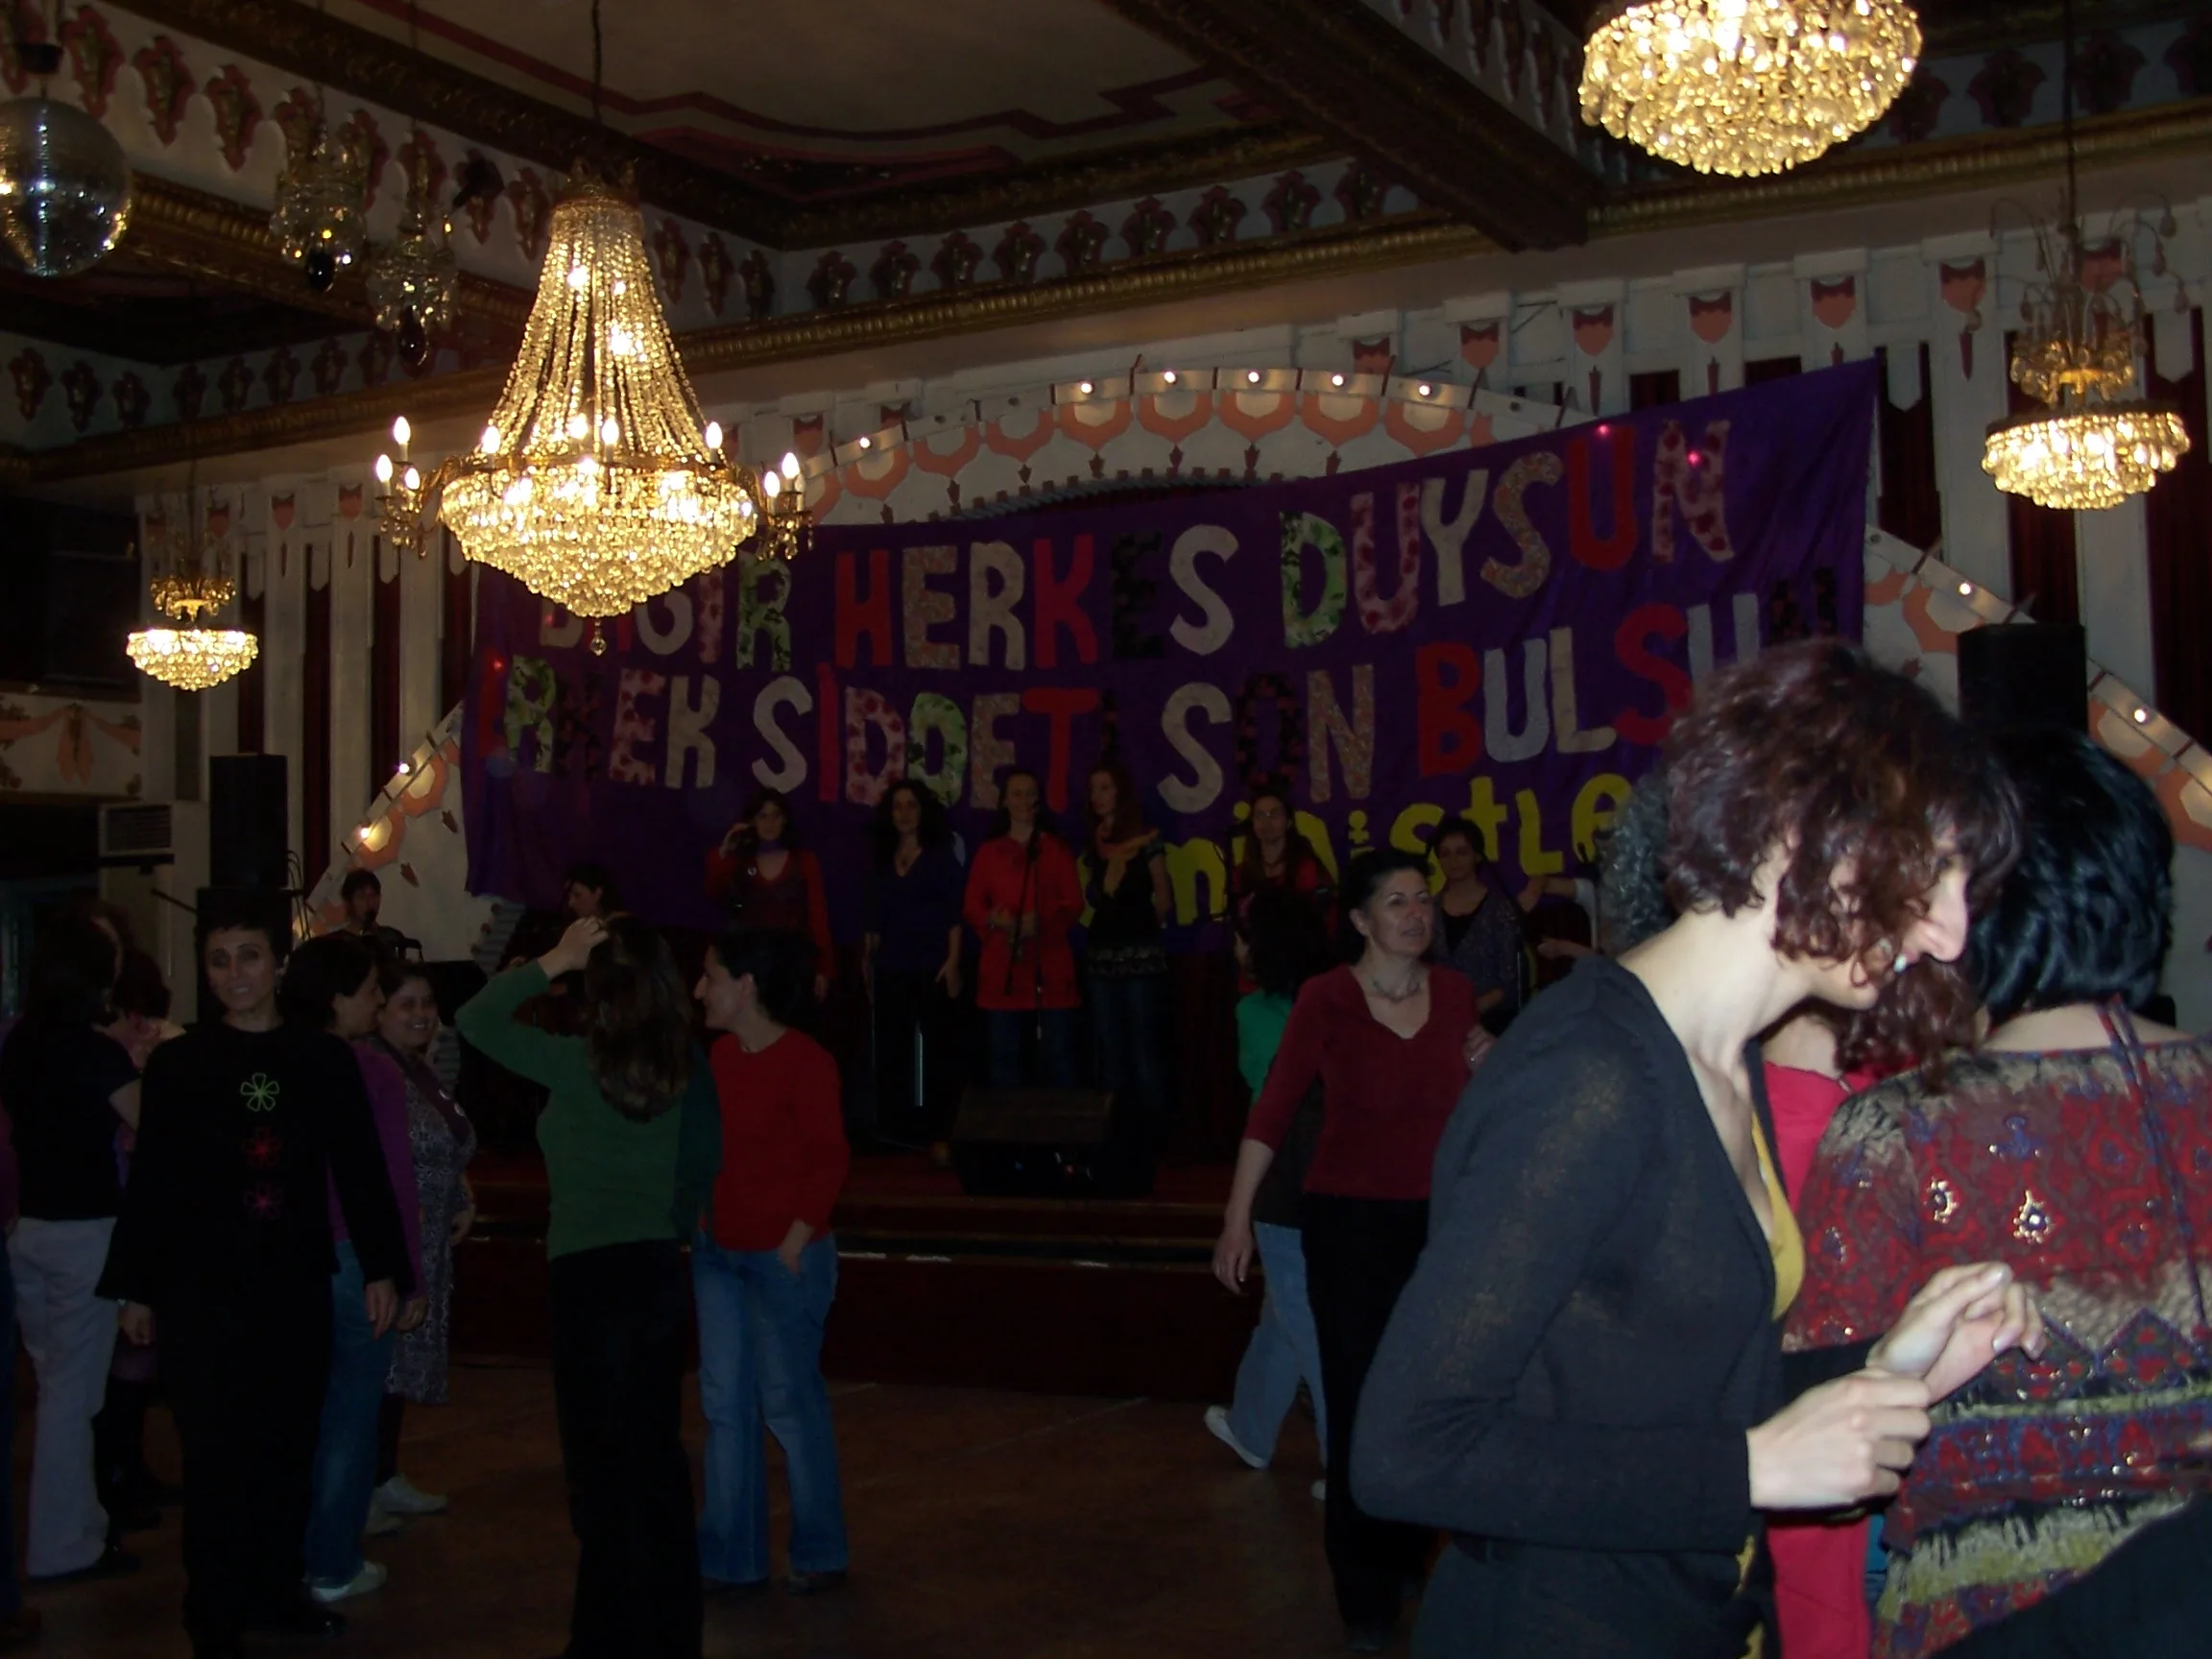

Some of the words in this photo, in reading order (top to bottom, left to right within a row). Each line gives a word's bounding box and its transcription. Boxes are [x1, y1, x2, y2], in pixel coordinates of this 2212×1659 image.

[540, 549, 792, 672] GIR
[833, 523, 1240, 672] HERKES
[1278, 419, 1737, 649] DUYSUN
[1156, 663, 1375, 814] SON
